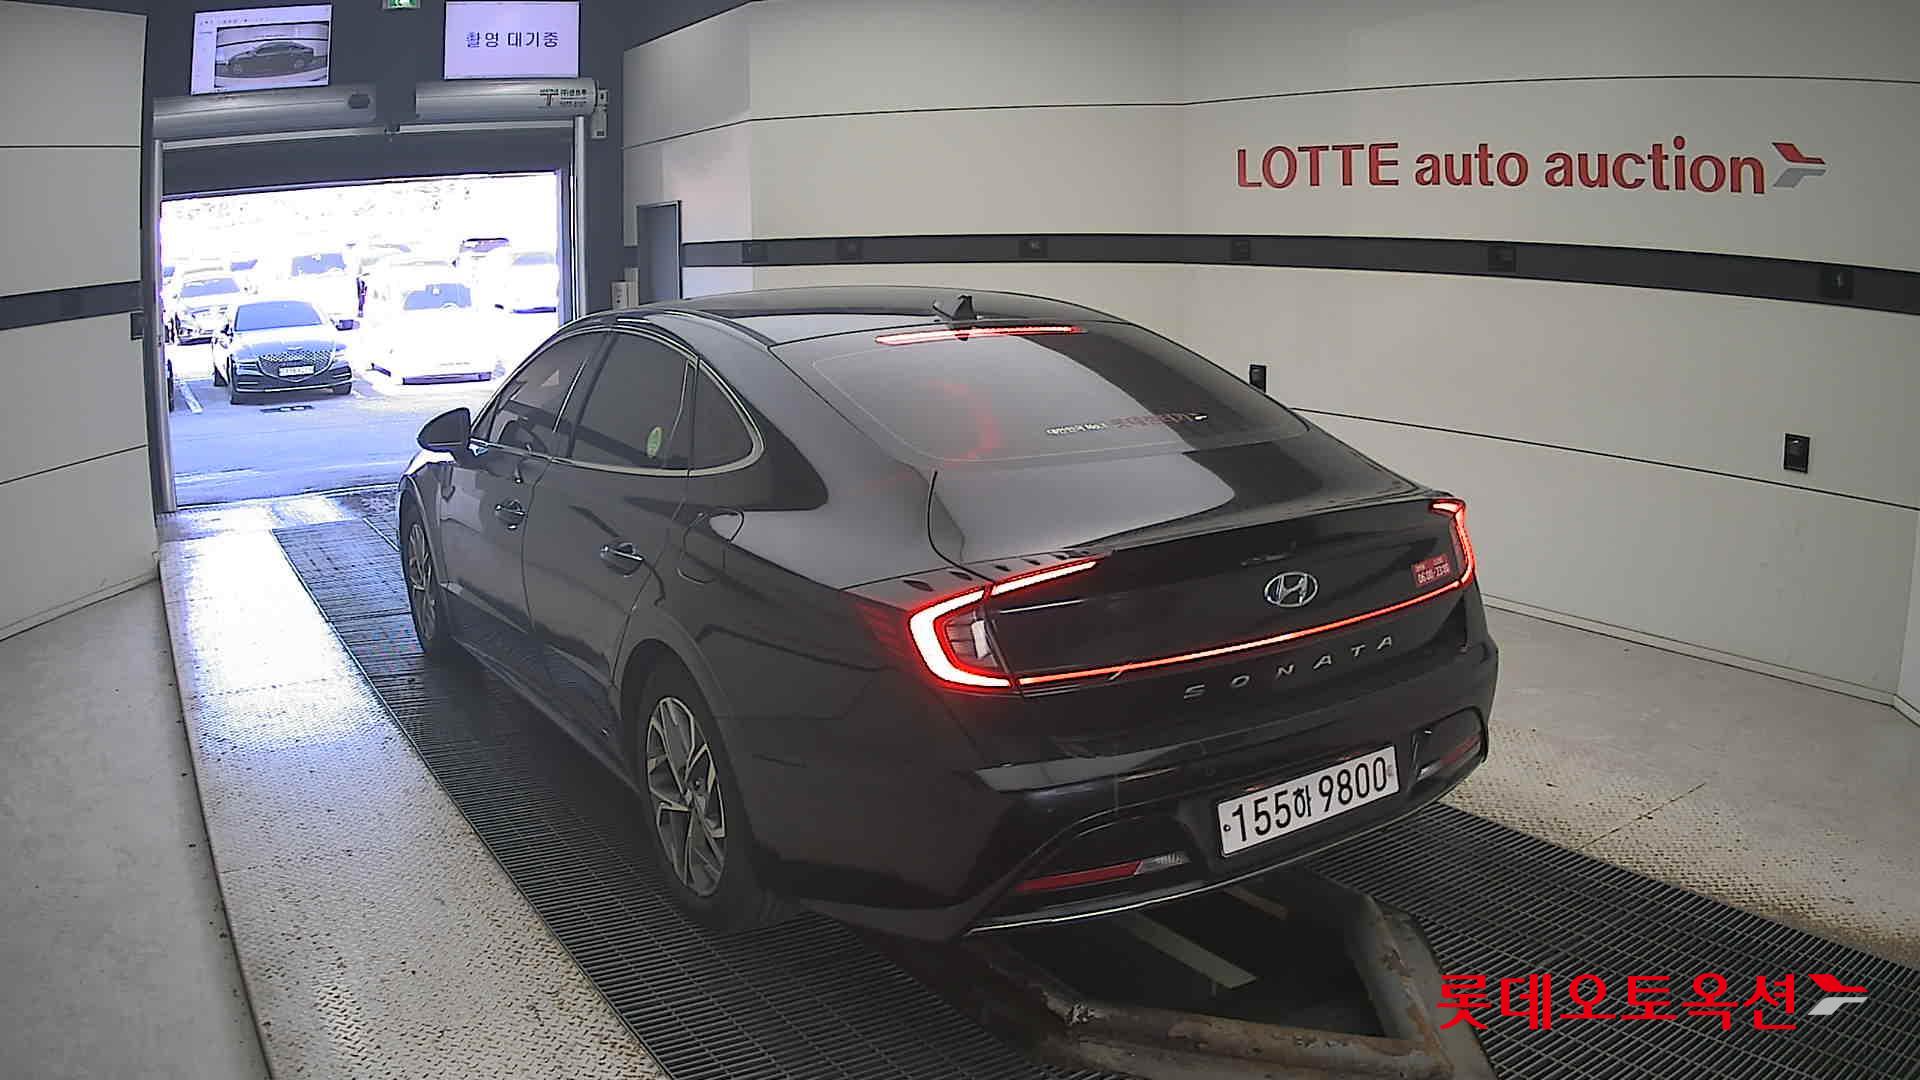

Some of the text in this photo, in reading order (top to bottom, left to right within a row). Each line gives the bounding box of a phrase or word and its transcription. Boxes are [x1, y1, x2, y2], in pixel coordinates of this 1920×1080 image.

[507, 31, 560, 48] 대기중
[1238, 136, 1766, 194] LOTTE auto auction
[1183, 635, 1393, 700] SONATA
[1231, 756, 1388, 842] 155하 9800
